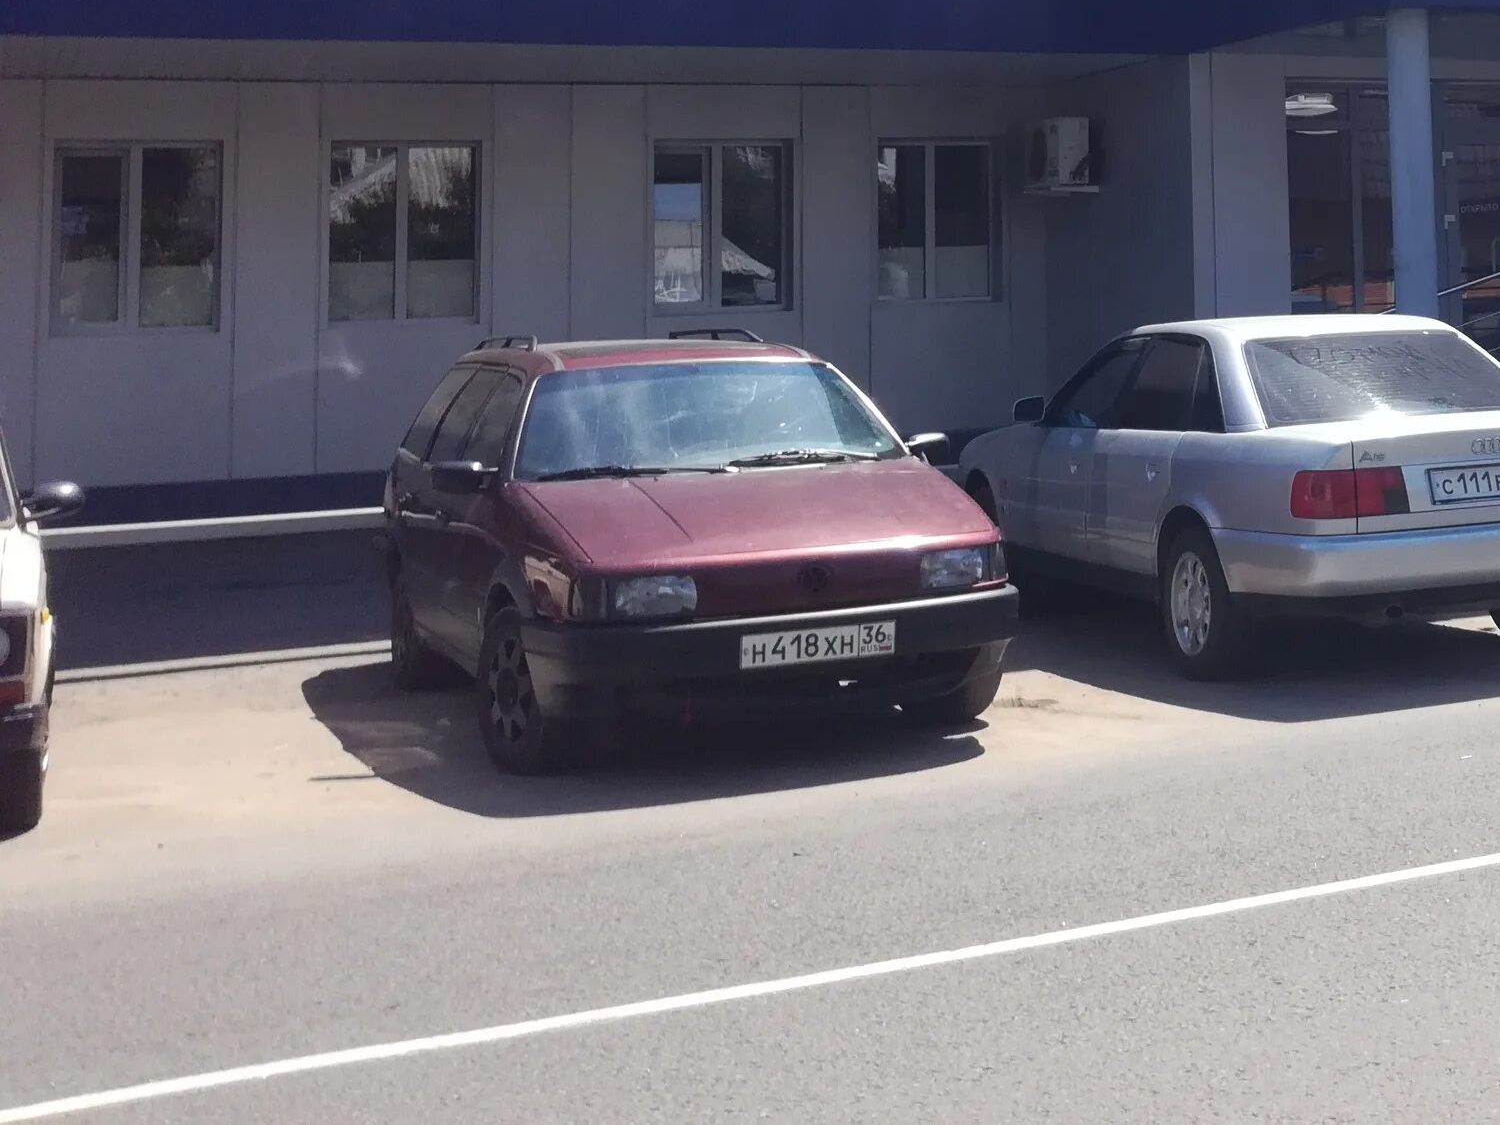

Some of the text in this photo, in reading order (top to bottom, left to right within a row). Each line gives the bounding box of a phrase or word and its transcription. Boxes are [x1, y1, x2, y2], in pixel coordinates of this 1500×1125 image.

[752, 625, 887, 665] Н418ХН 36
[860, 644, 880, 654] RUS
